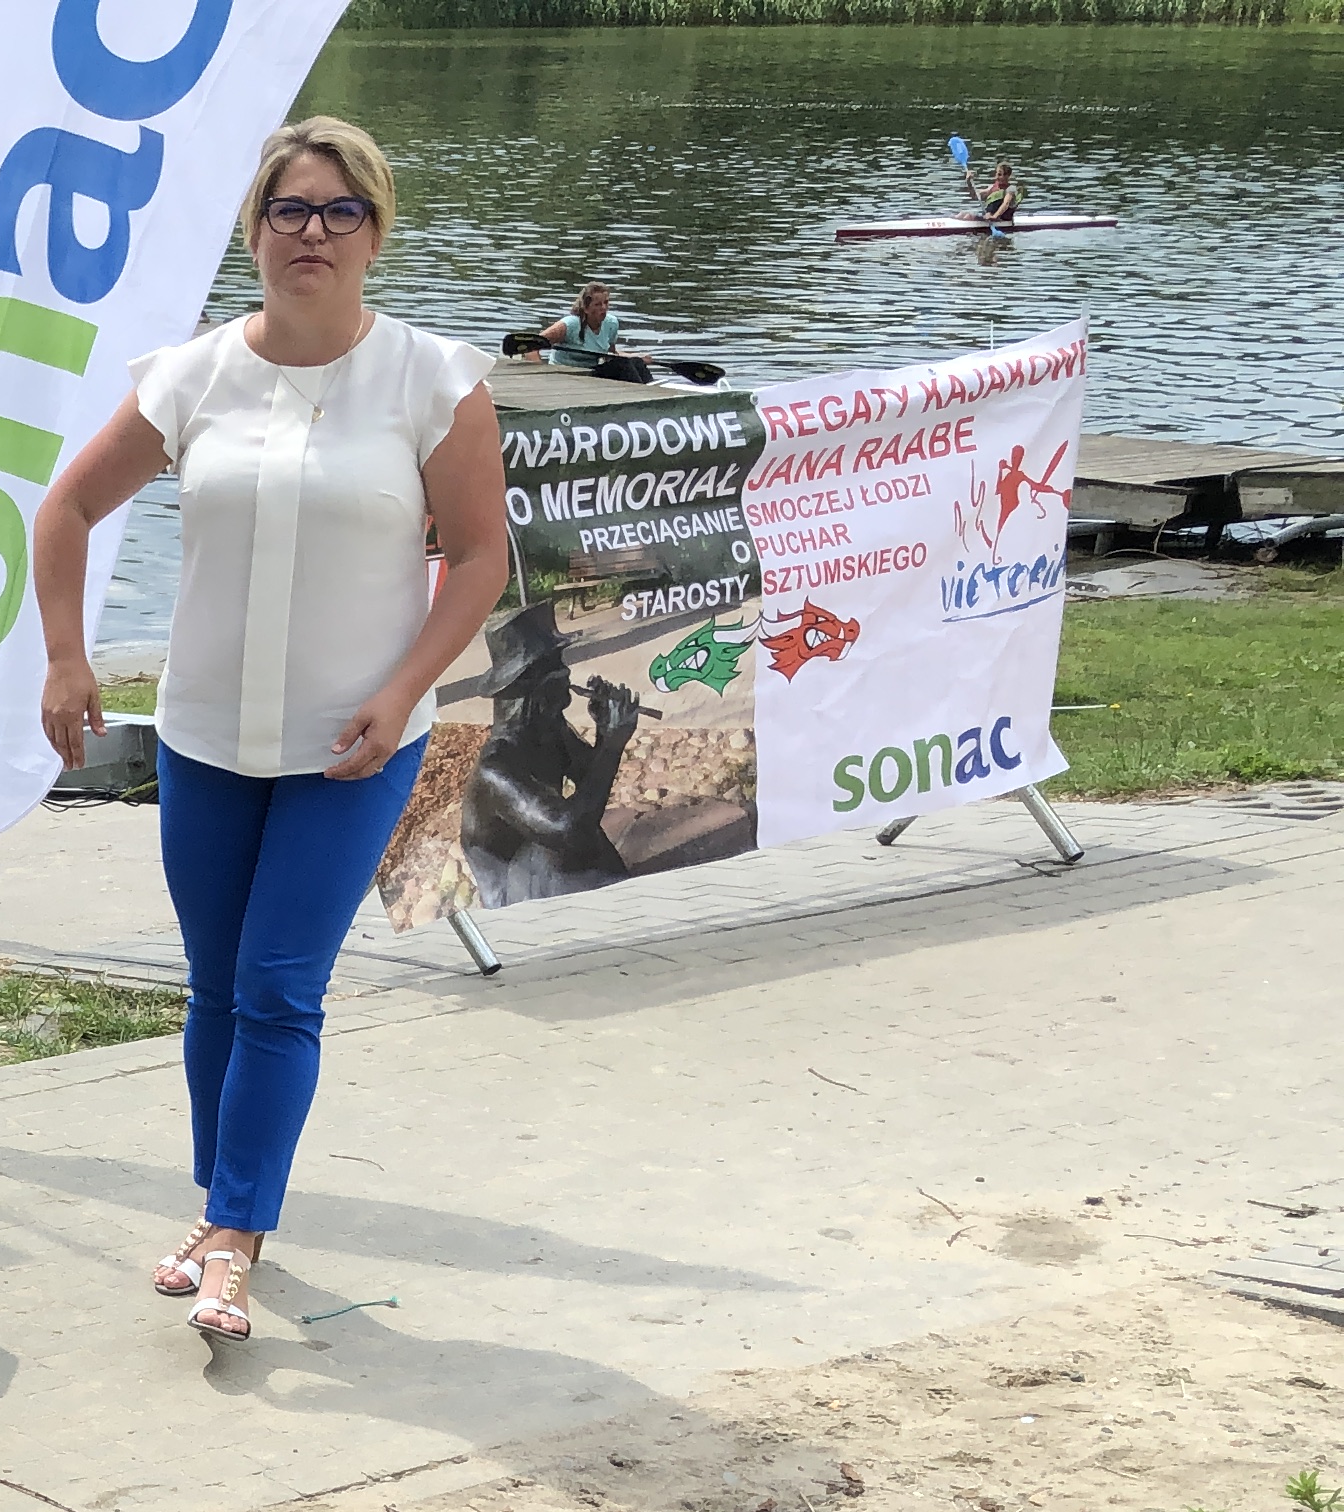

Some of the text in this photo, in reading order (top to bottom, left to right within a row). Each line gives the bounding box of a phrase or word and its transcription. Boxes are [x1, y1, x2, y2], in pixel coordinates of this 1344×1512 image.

[762, 384, 909, 441] REGATY
[541, 462, 740, 522] MEMORIAŁ
[747, 443, 846, 491] JANA
[853, 416, 978, 473] RAABE
[579, 473, 932, 554] PRZECIĄGANIE SMOCZEJ ŁODZI
[732, 523, 853, 564] O PUCHAR
[621, 542, 928, 621] STAROSTY SZTUMSKIEGO
[833, 716, 1023, 812] sonac
